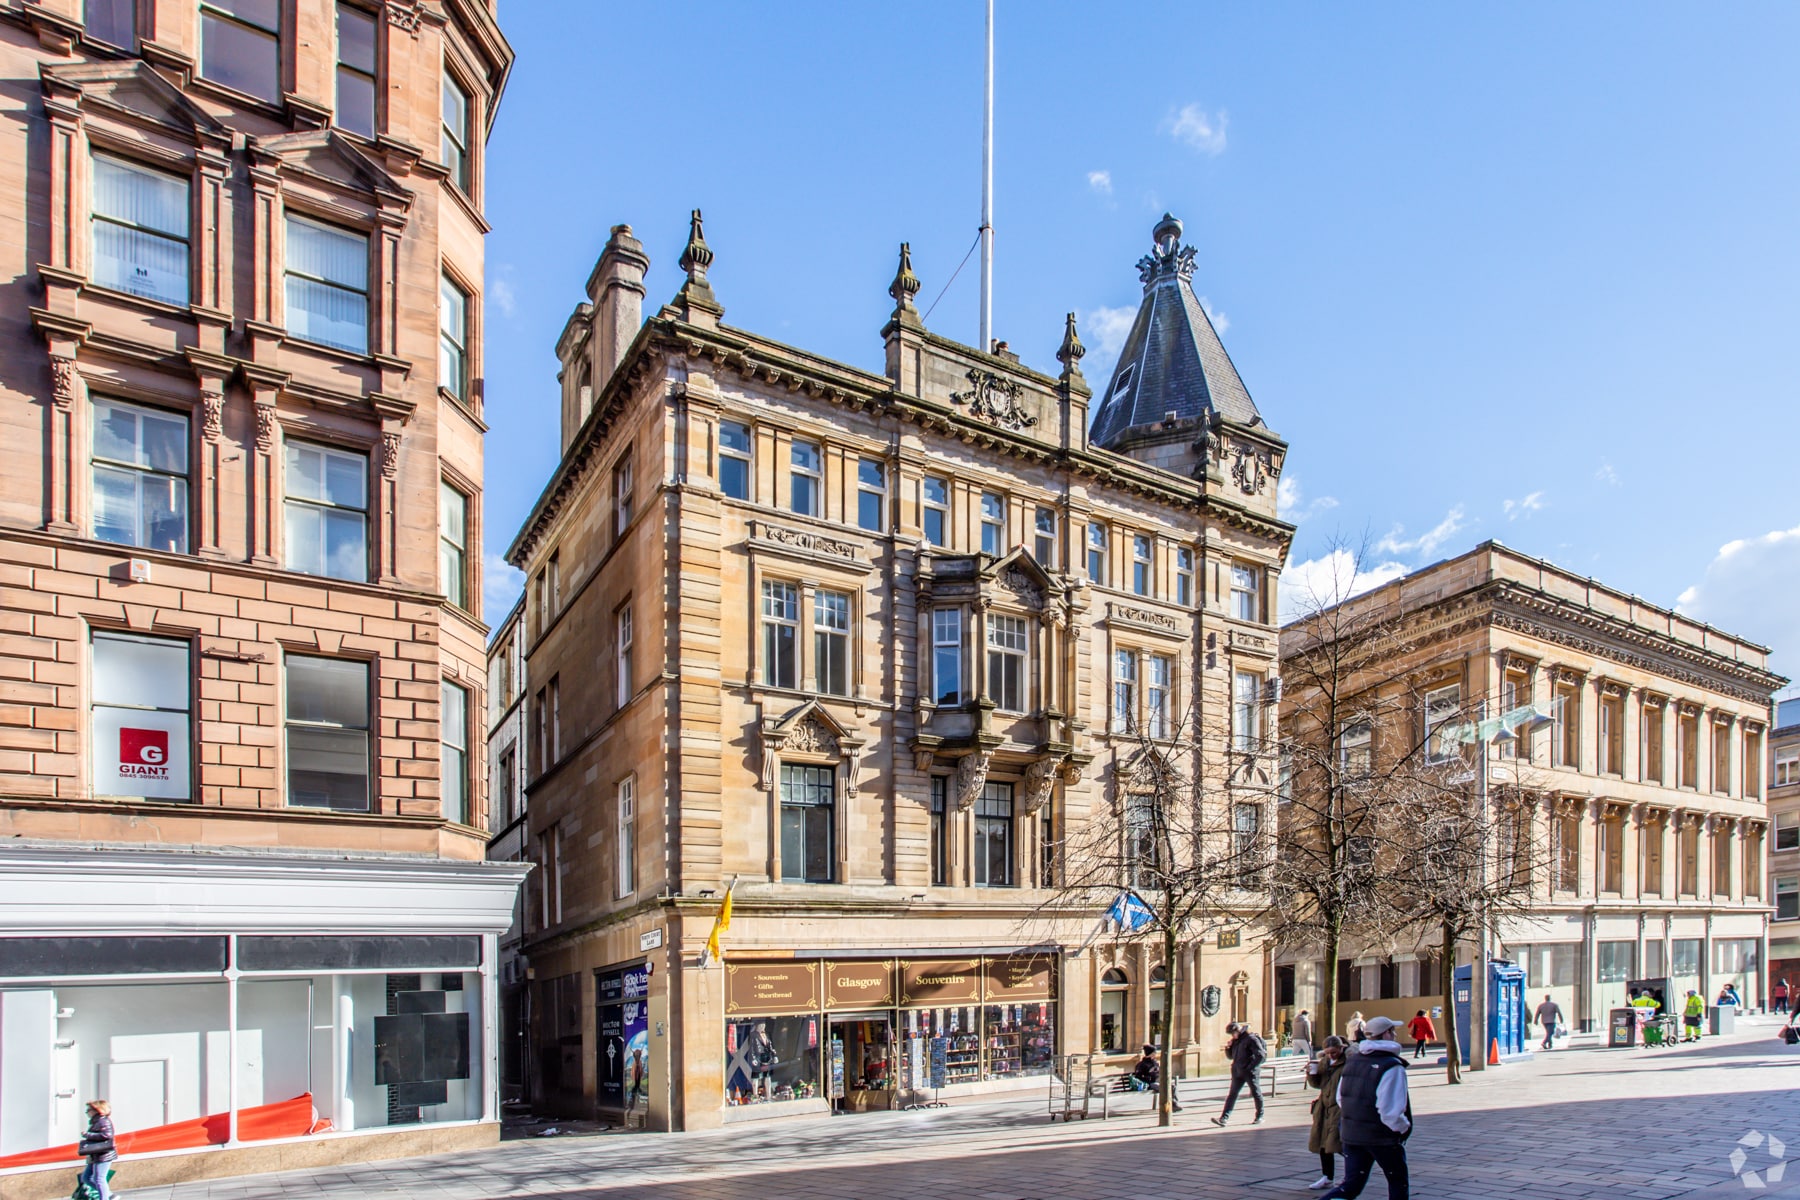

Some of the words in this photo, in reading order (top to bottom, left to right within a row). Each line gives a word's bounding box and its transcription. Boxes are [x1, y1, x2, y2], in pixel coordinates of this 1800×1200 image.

[140, 746, 162, 762] G
[120, 765, 168, 775] GIANT
[837, 977, 882, 989] Glasgow
[916, 975, 965, 985] Souvenirs
